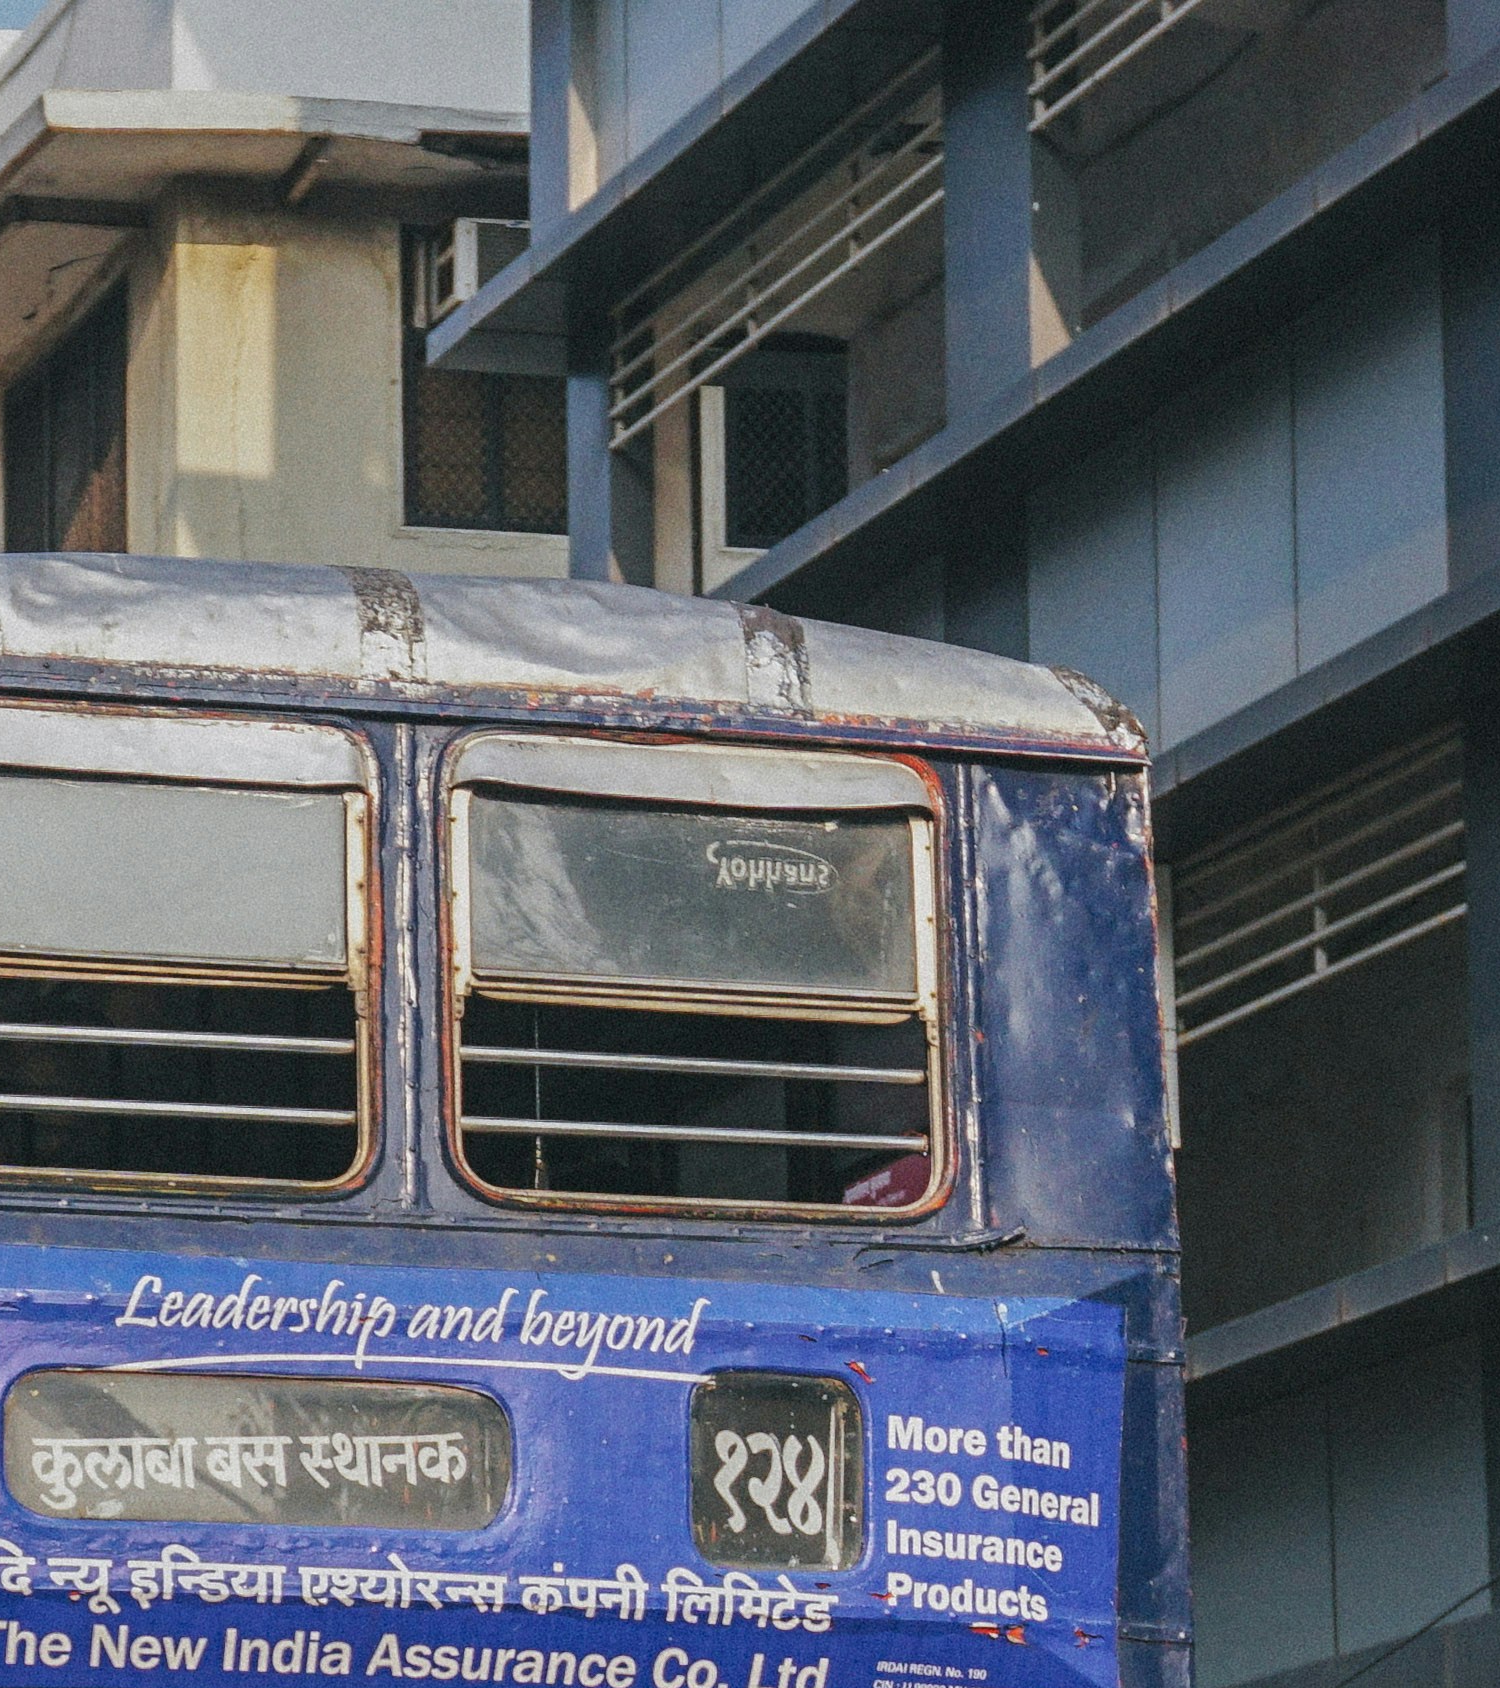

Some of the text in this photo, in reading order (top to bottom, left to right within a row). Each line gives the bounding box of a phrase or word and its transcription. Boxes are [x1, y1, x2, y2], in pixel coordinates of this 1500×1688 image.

[115, 1274, 712, 1381] Leadership and beyond
[886, 1414, 1072, 1469] More than
[30, 1431, 468, 1512] कुलाबा बस स्थानक
[712, 1428, 826, 1536] १२४
[885, 1468, 1100, 1527] 230 General
[886, 1519, 1063, 1573] Insurance
[47, 1553, 122, 1616] न्यू
[129, 1543, 285, 1613] इन्डिया
[298, 1554, 509, 1614] एश्योरन्स
[518, 1561, 651, 1622] कंपनी
[660, 1566, 839, 1633] लिमिटेड
[886, 1572, 1048, 1623] Products
[88, 1622, 208, 1671] New
[223, 1628, 353, 1677] India
[876, 1660, 909, 1675] IRDAI
[945, 1666, 965, 1679] No.
[967, 1668, 988, 1681] 190
